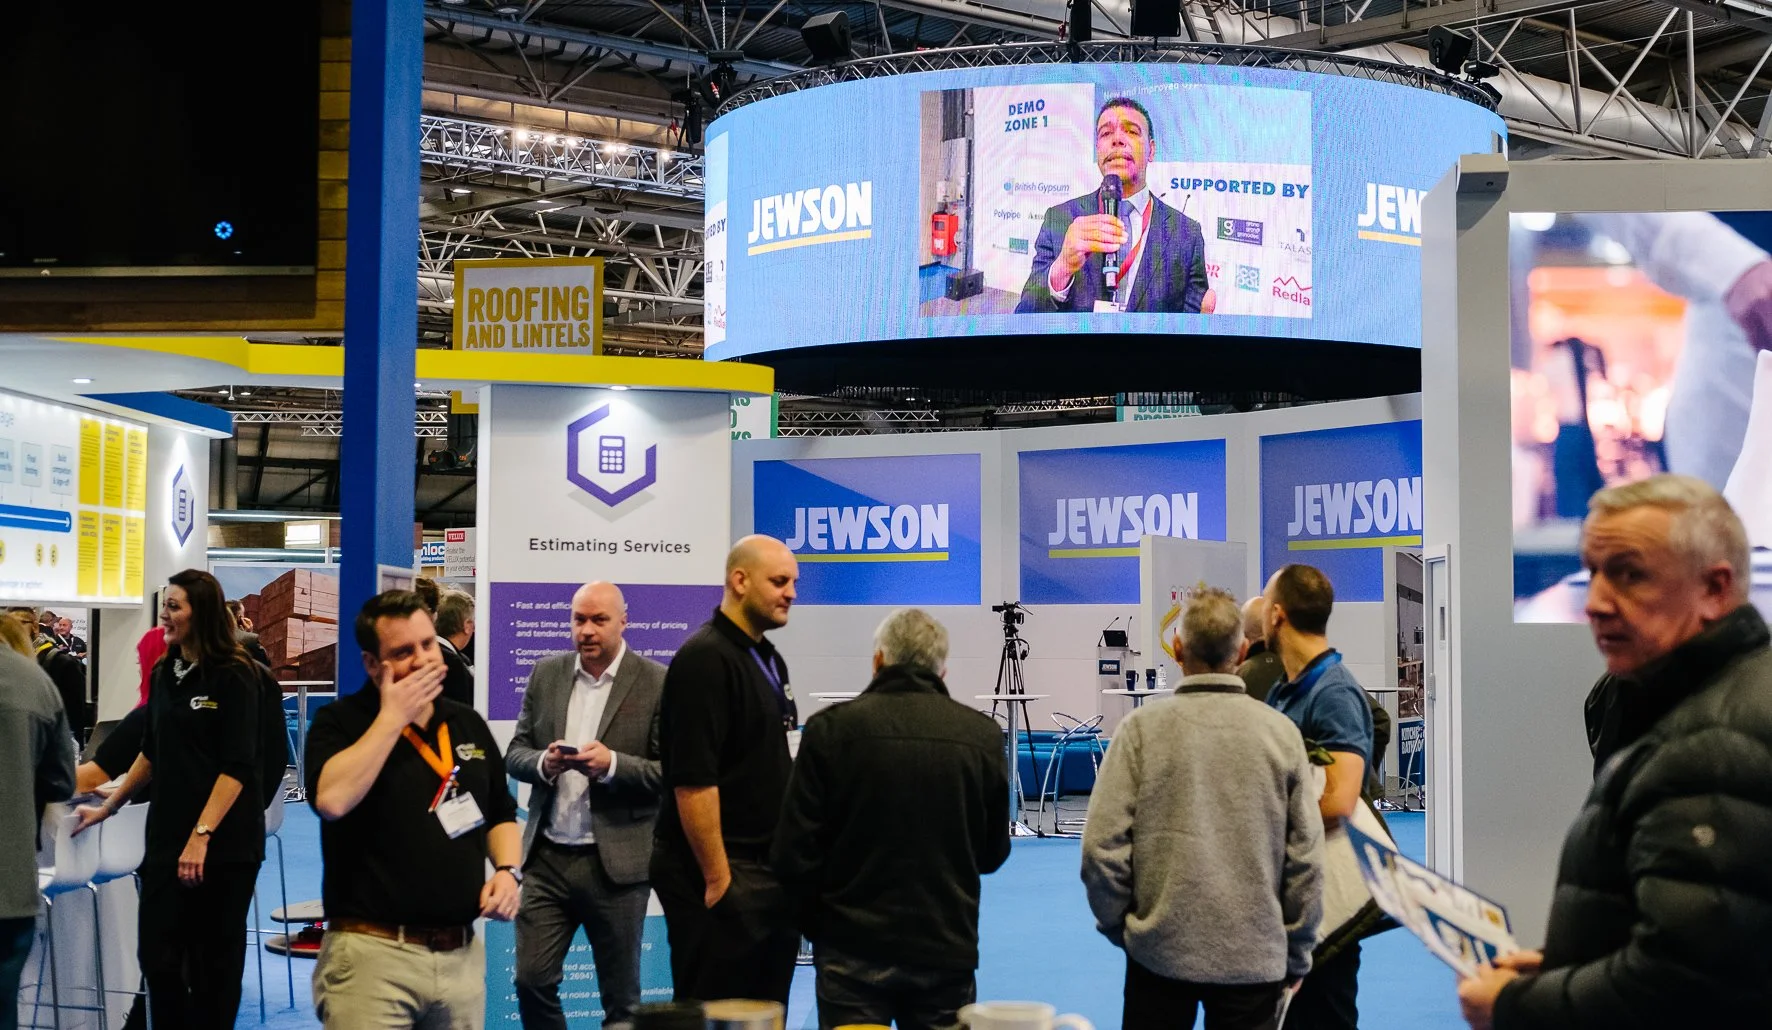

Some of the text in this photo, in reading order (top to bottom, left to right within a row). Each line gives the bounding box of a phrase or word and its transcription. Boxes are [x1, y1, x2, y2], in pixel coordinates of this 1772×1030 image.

[1009, 99, 1045, 116] DEMO
[1005, 115, 1048, 132] ZONE 1
[1015, 182, 1069, 193] British Gypsum
[1171, 178, 1309, 198] SUPPORTED BY
[748, 181, 872, 244] JEWSON
[994, 209, 1021, 220] Polypipe
[468, 286, 589, 322] ROOFING
[466, 322, 590, 348] AND LINTELS
[1288, 476, 1422, 536] JEWSON
[786, 503, 949, 550] JEWSON
[1048, 492, 1198, 546] JEWSON
[529, 538, 691, 554] Estimating Services
[516, 620, 539, 628] Saves
[541, 620, 558, 628] time
[652, 621, 660, 629] of
[661, 621, 688, 630] pricing
[533, 630, 571, 638] tendering
